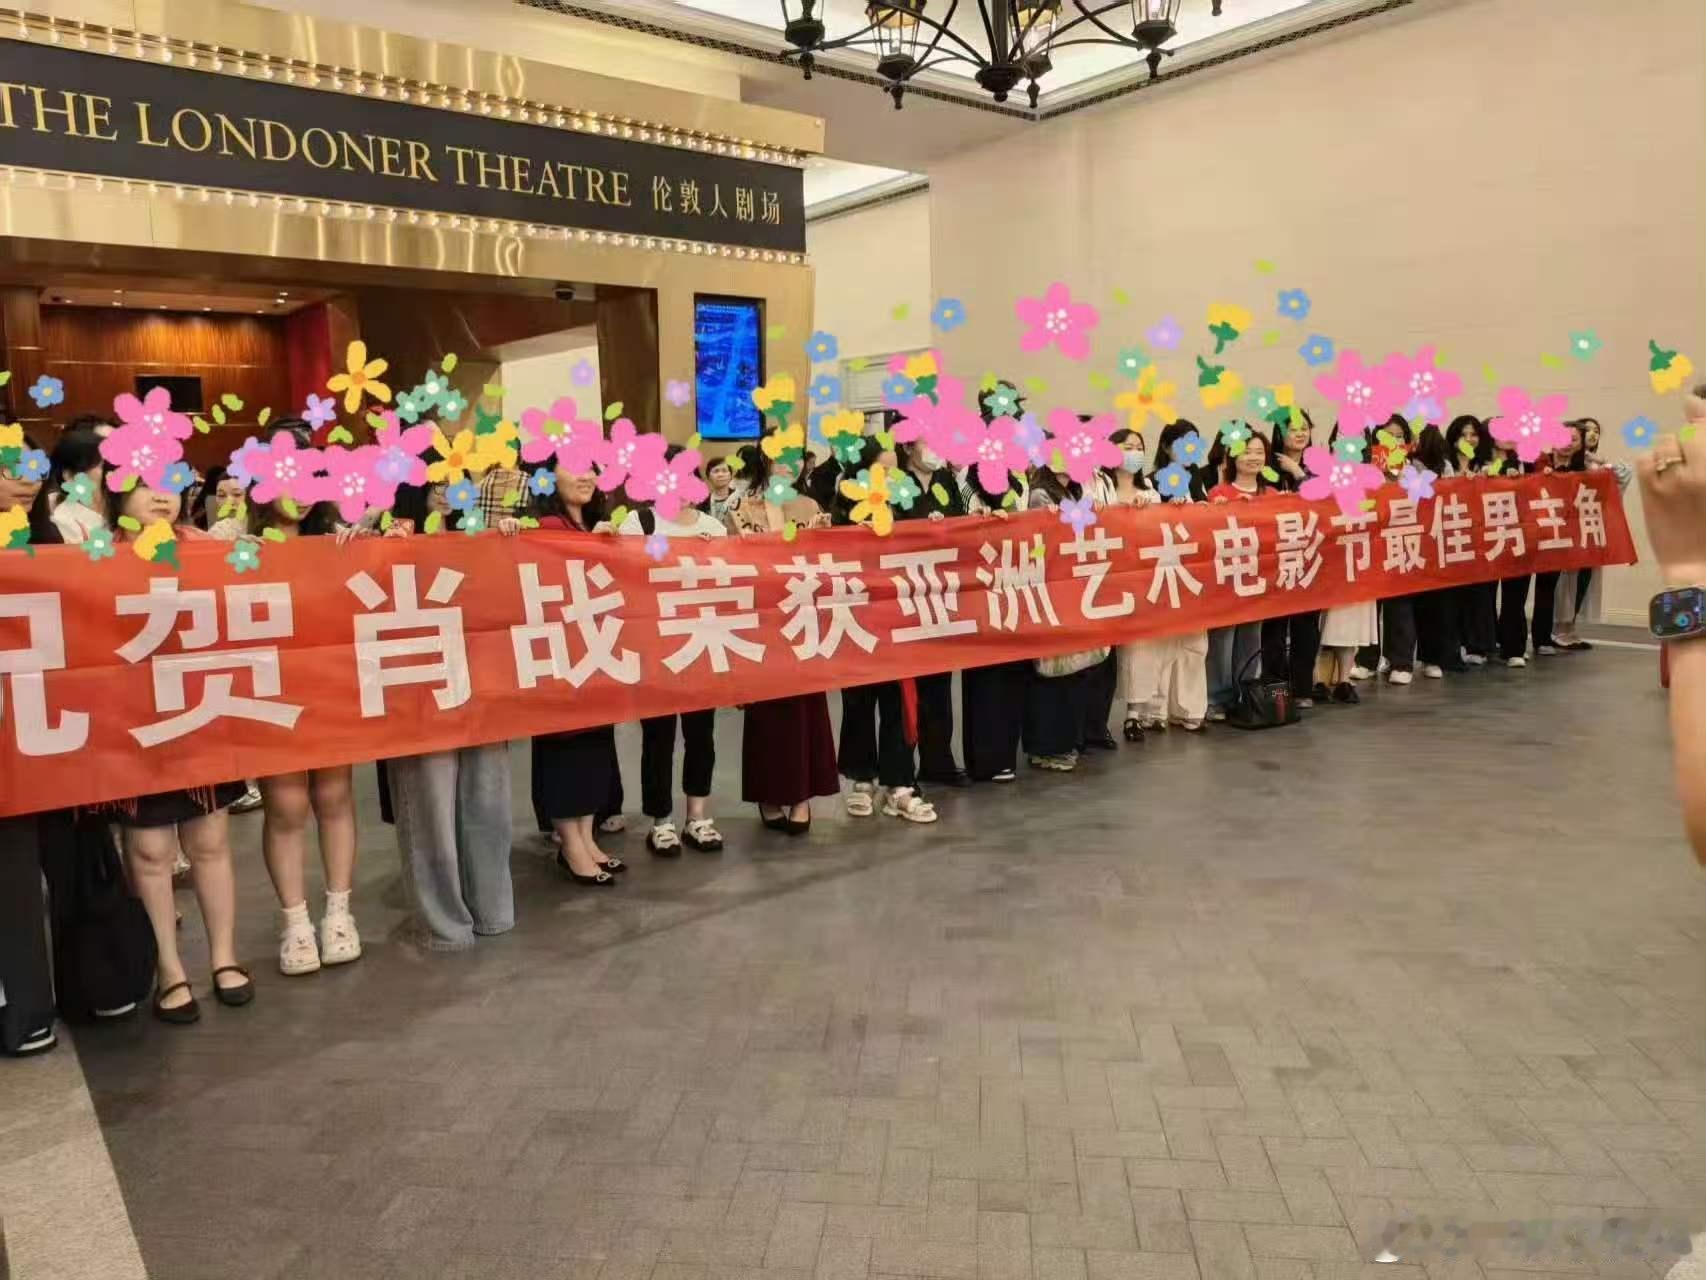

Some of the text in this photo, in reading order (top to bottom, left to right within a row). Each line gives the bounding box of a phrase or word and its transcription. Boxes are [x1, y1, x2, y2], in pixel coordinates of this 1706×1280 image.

[0, 81, 632, 207] THE LONDONER THEATRE
[651, 175, 782, 225] 伦敦人剧场
